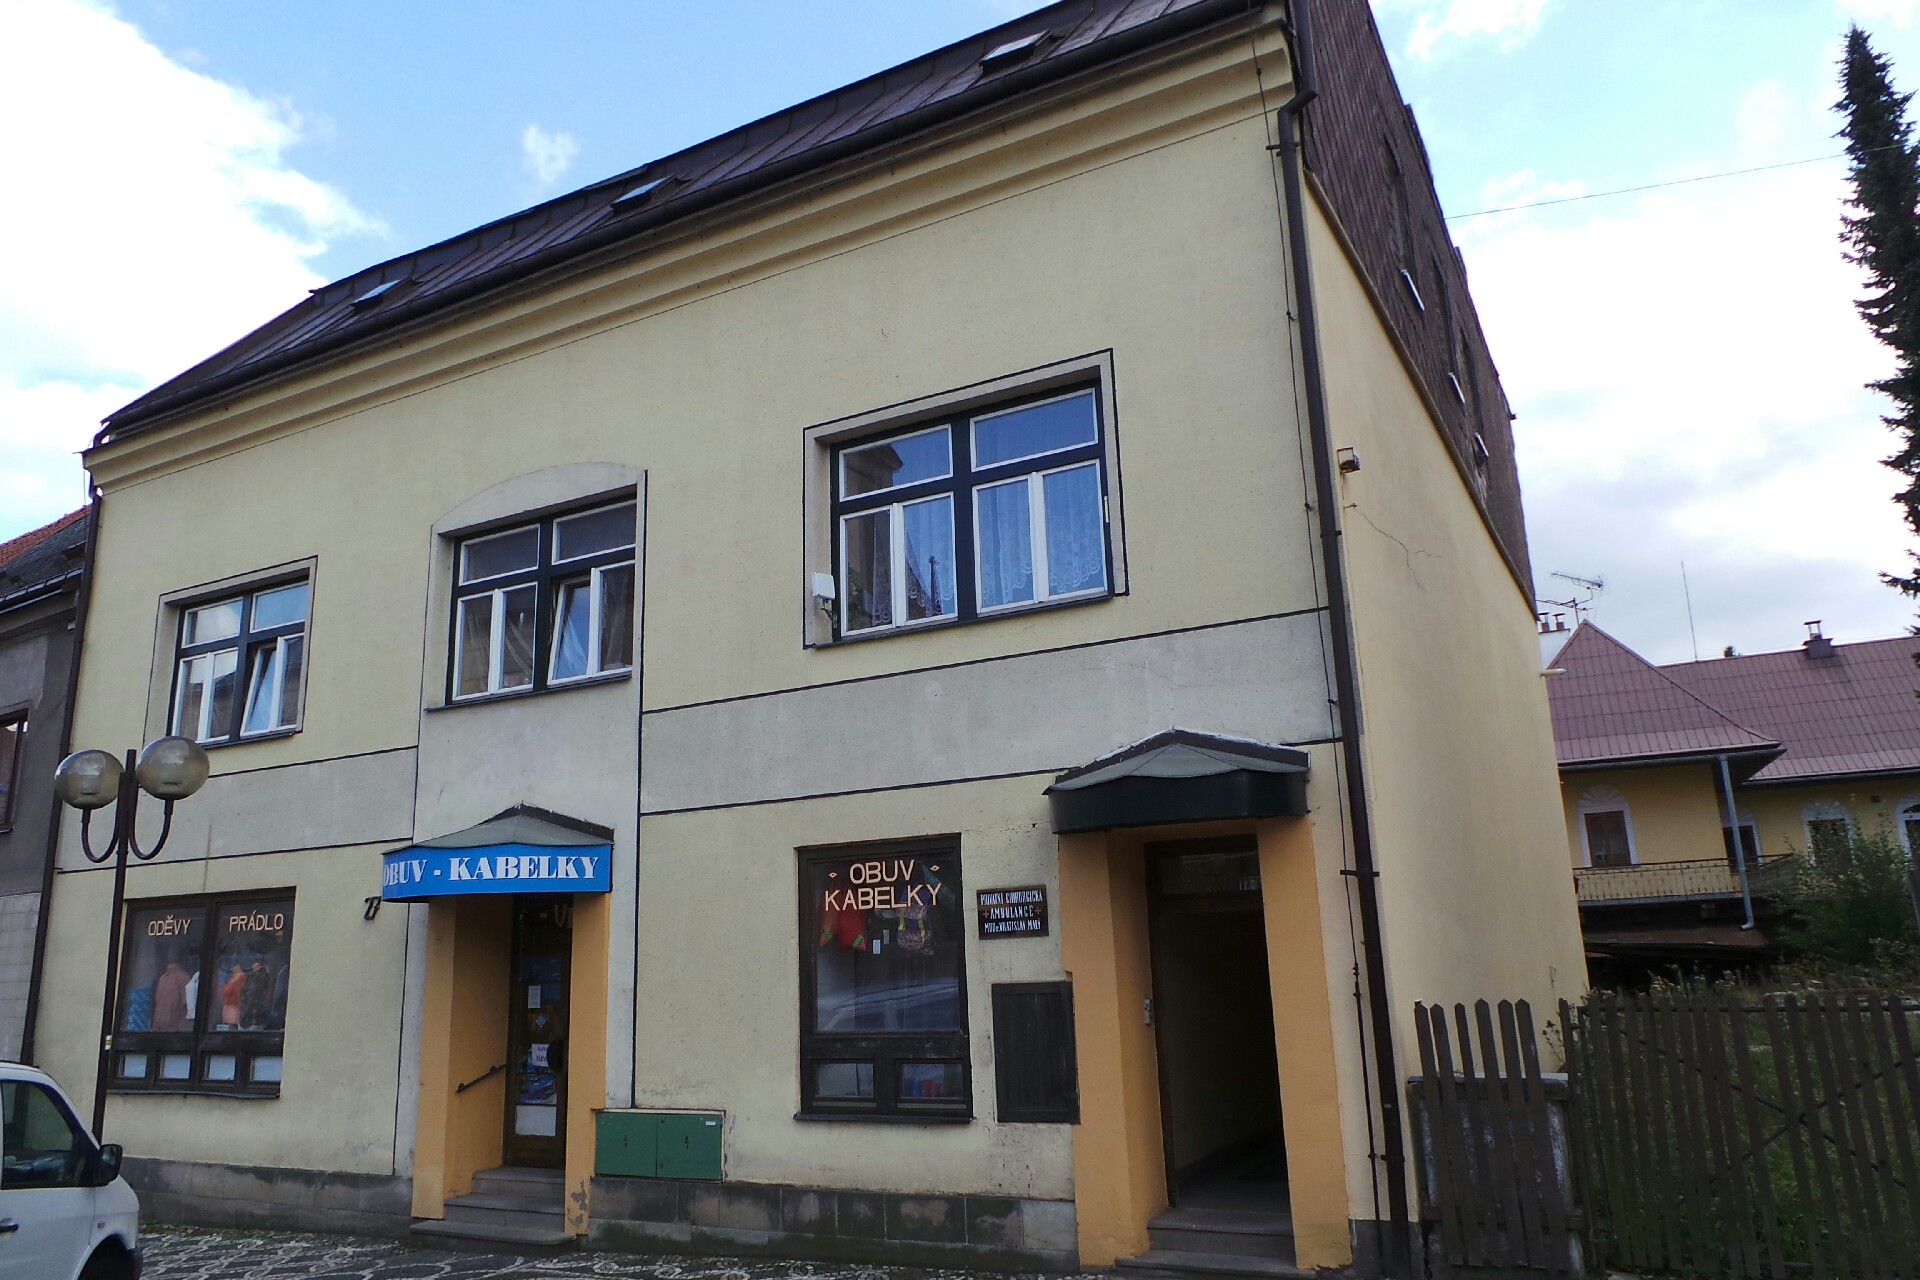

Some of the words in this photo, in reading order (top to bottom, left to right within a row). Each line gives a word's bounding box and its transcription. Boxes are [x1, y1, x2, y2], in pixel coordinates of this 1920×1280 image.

[383, 859, 428, 887] OBUV
[449, 856, 599, 881] KABELKY
[849, 859, 915, 885] OBUV
[825, 883, 942, 912] KABELKY
[228, 910, 284, 933] PRÁDLO
[990, 905, 1034, 919] AMBULANCE
[148, 914, 191, 936] ODĚVY
